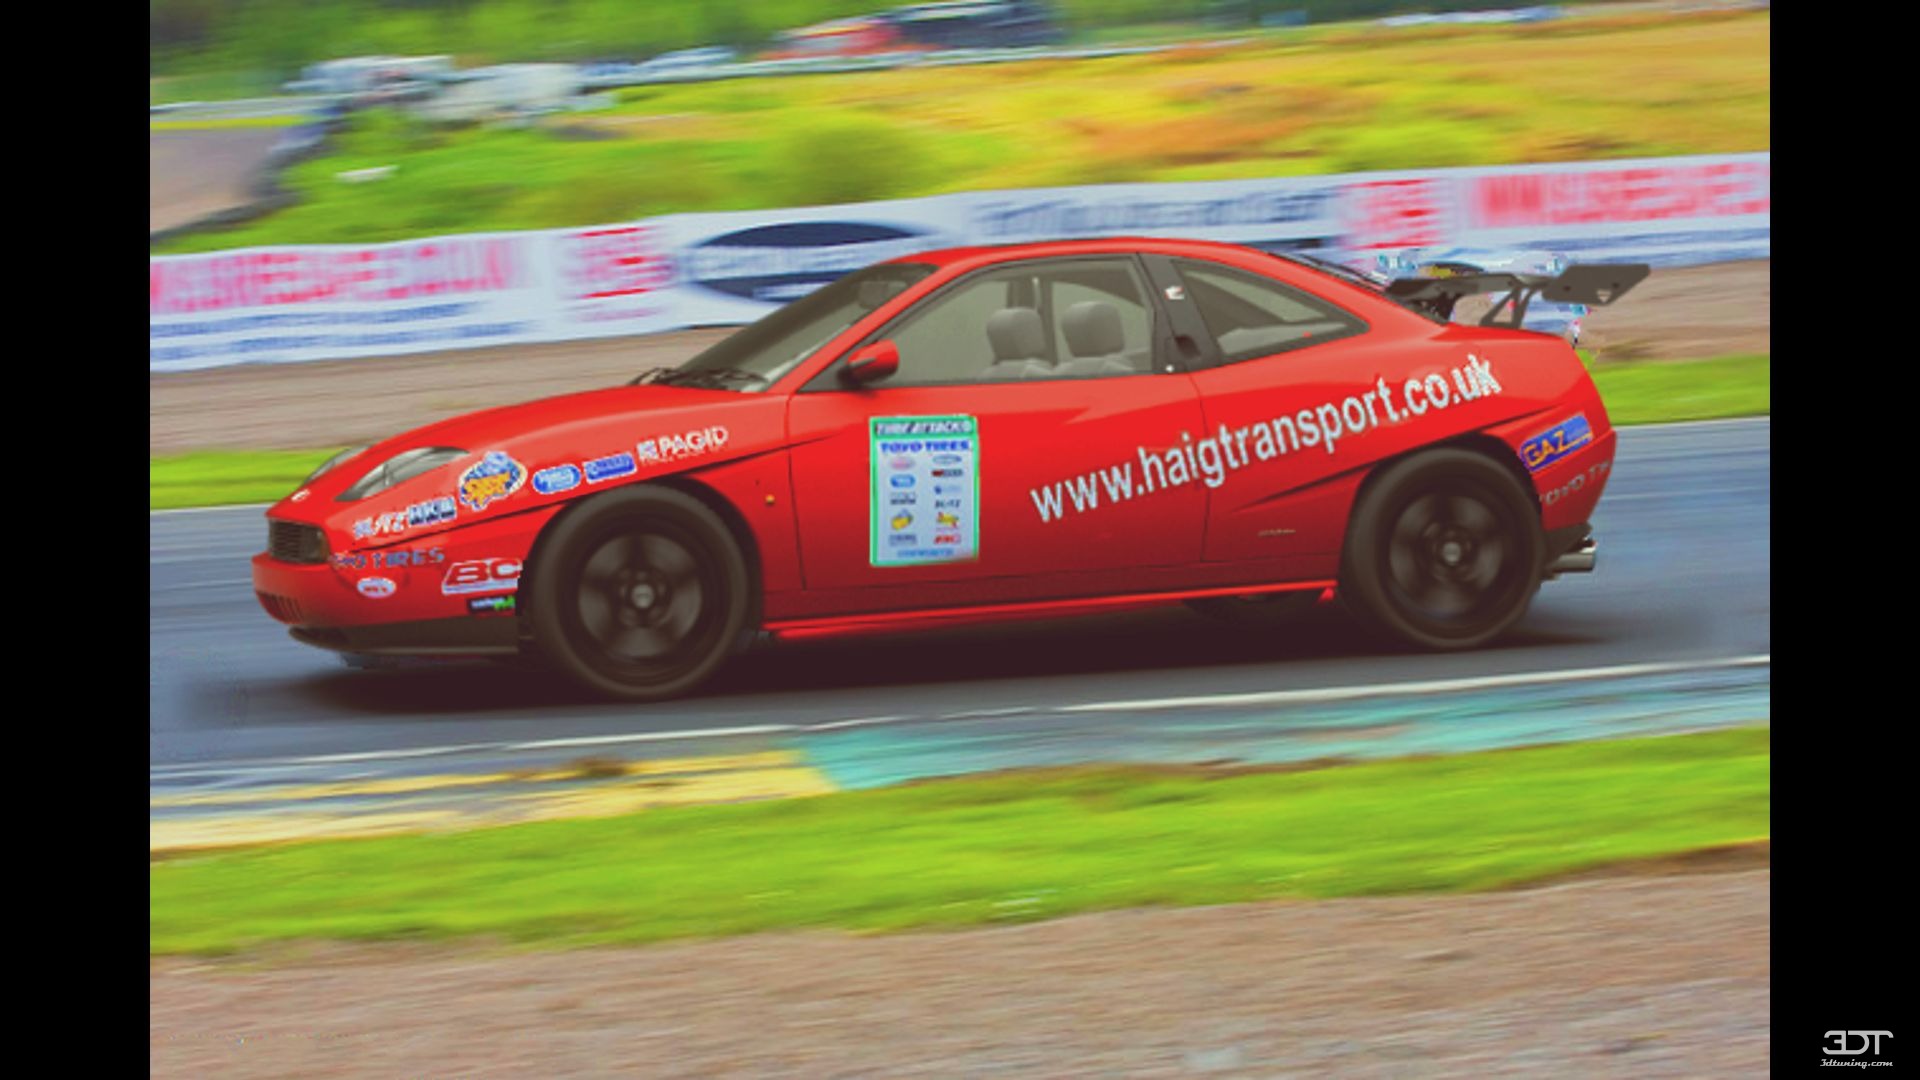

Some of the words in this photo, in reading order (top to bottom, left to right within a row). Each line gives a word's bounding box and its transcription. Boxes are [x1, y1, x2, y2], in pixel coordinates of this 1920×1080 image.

[657, 426, 729, 457] PAGID
[1030, 354, 1502, 523] www.haigtransport.co.uk
[1523, 430, 1566, 467] GAZ
[448, 558, 521, 586] BC
